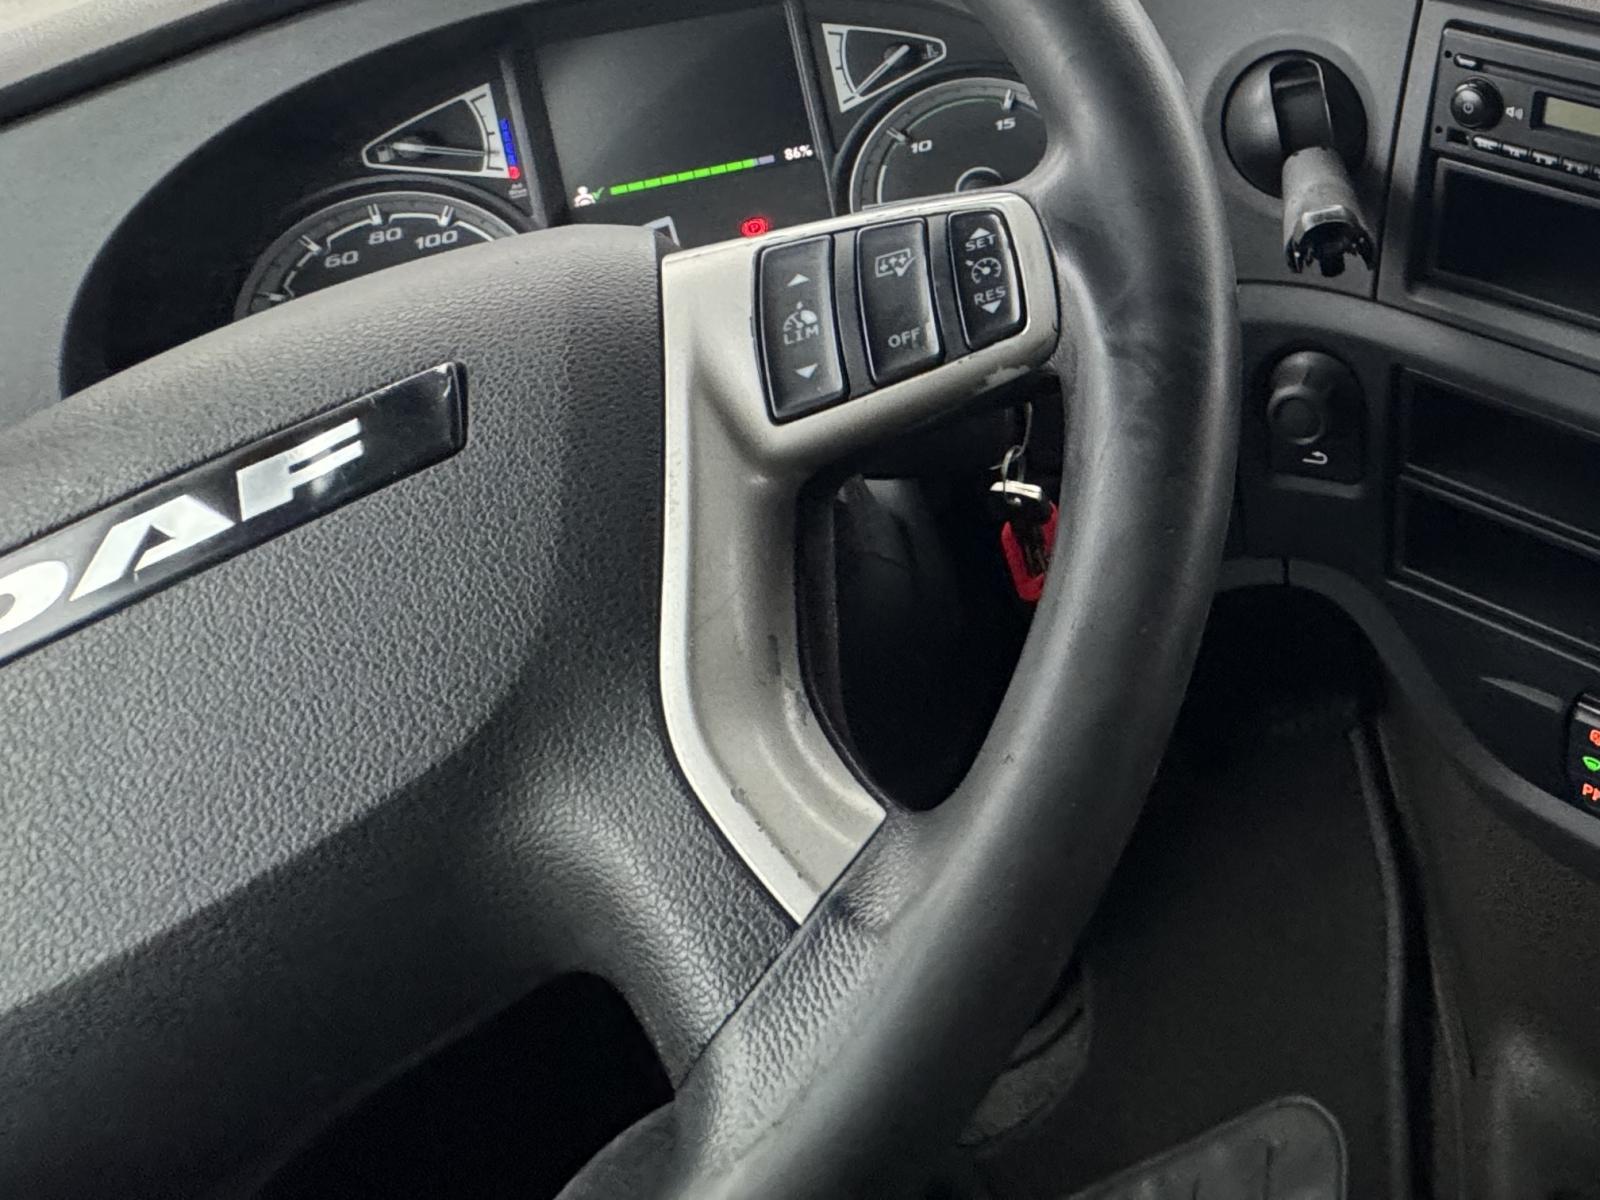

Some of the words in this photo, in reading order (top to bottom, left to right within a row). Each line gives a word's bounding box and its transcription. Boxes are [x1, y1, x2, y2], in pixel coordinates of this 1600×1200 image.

[994, 117, 1016, 131] 15
[783, 144, 813, 161] 86%
[910, 139, 932, 154] 10
[368, 227, 403, 246] 80
[415, 230, 458, 251] 100
[965, 233, 996, 252] SET
[323, 250, 359, 269] 60
[973, 286, 1006, 305] RES
[783, 324, 820, 345] LIM
[887, 327, 921, 349] OFF
